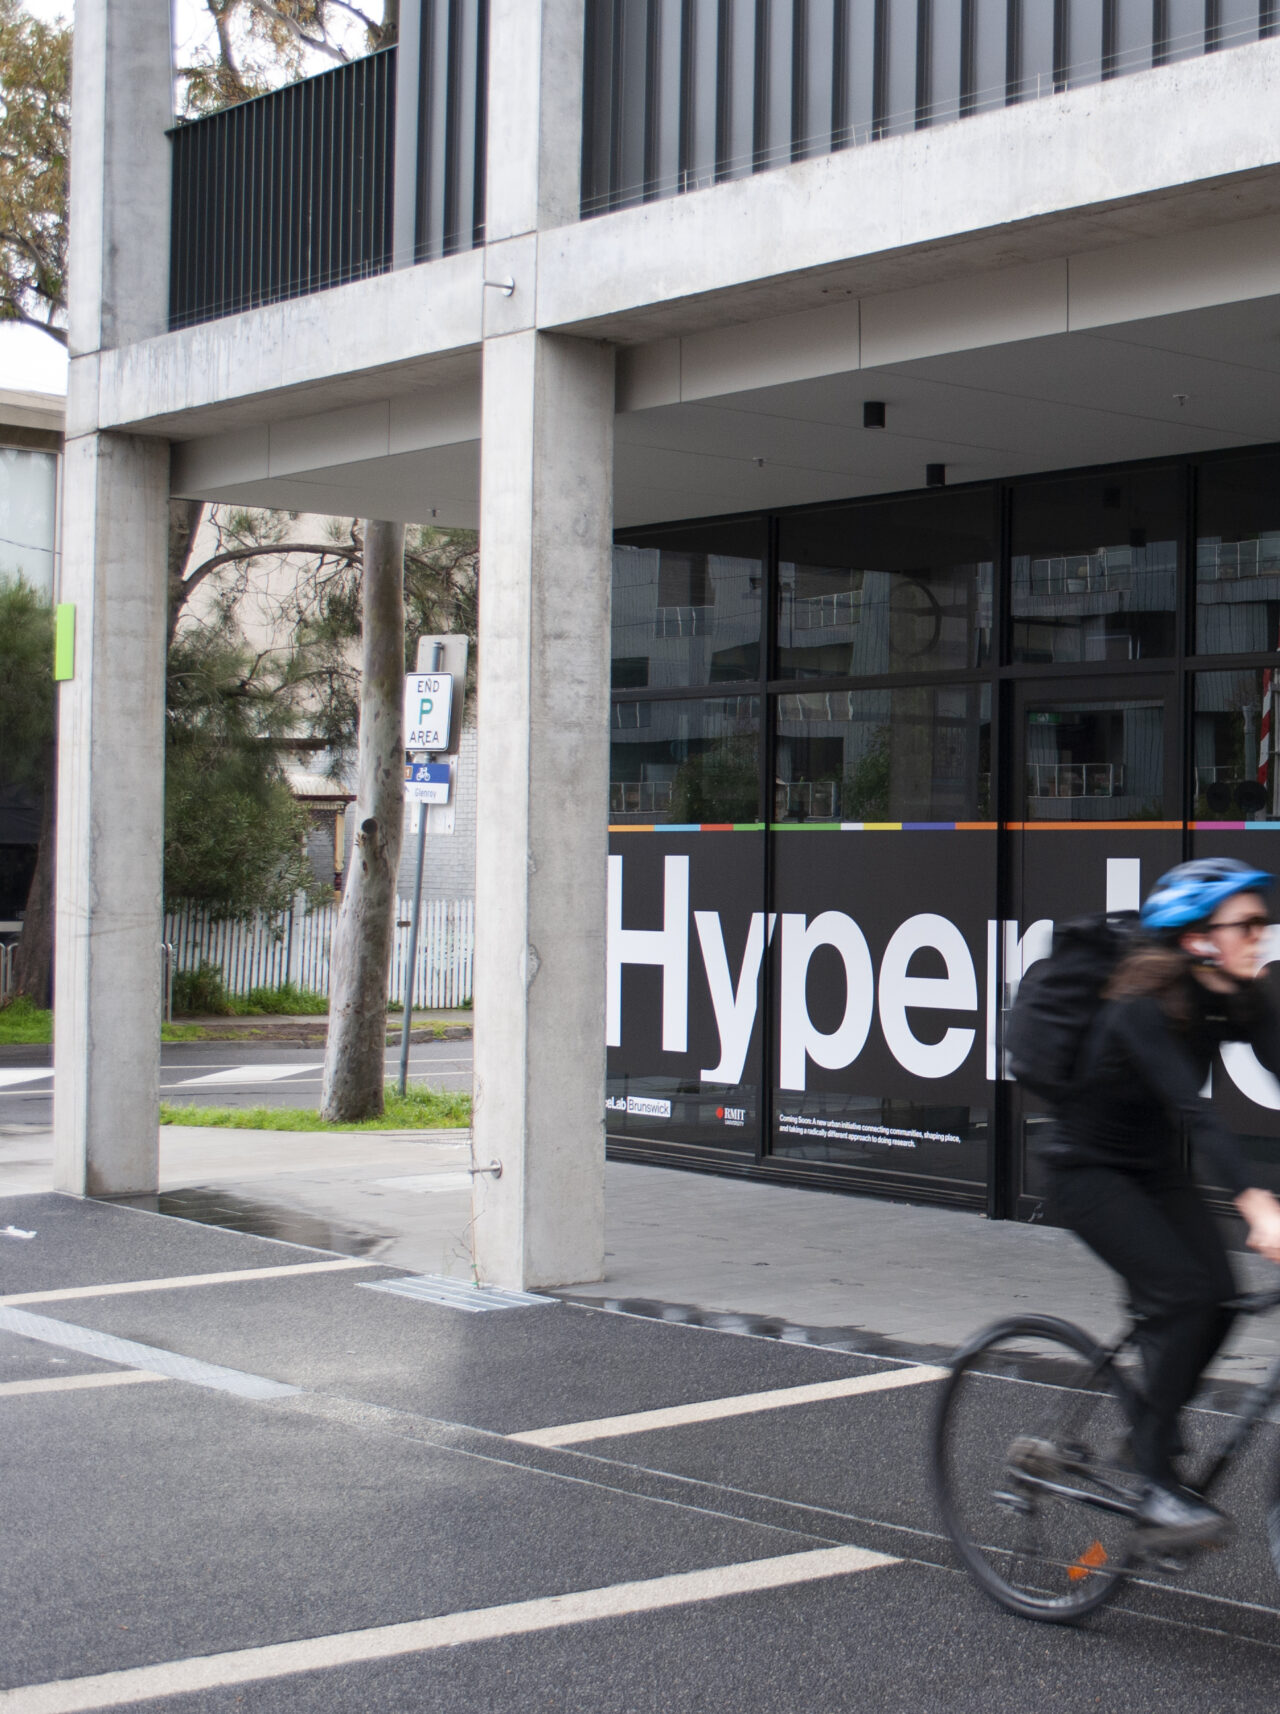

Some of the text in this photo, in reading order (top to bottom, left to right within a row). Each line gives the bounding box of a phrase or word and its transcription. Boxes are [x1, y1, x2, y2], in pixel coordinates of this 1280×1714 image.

[417, 680, 440, 693] END
[418, 698, 433, 725] P
[409, 731, 439, 744] AREA
[628, 1098, 669, 1115] Brunswick
[724, 1107, 746, 1120] RMIT
[779, 1113, 798, 1124] Coming
[861, 1125, 889, 1135] connecting
[924, 1131, 944, 1142] shaping
[788, 1125, 803, 1135] taking
[827, 1129, 848, 1139] different
[848, 1133, 871, 1142] approach
[877, 1136, 891, 1146] doing
